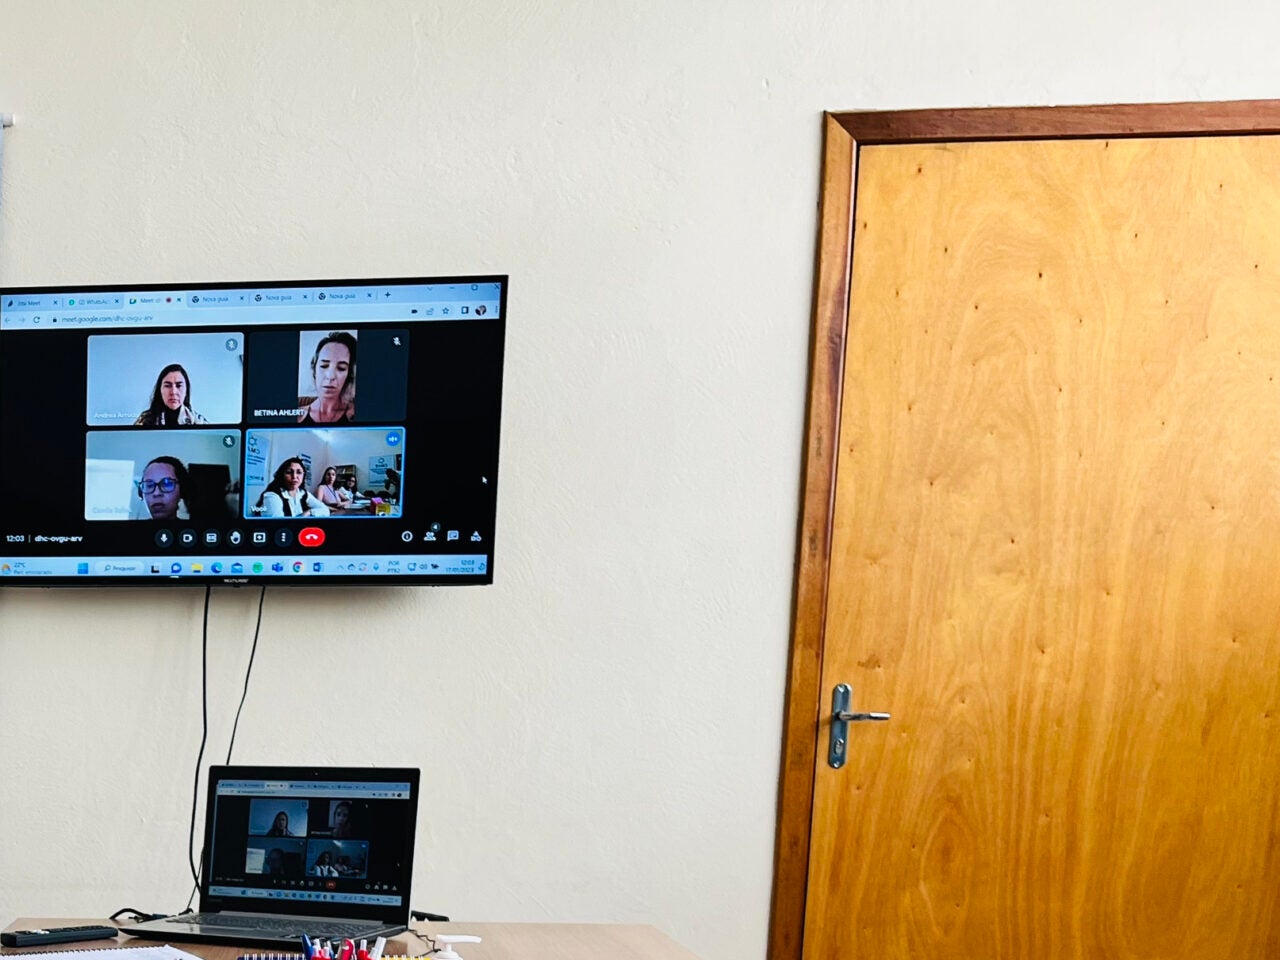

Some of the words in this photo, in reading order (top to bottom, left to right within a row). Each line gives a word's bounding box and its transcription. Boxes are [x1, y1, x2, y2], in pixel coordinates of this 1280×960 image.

[253, 409, 278, 417] BETINA
[278, 408, 305, 416] AHLERT
[6, 534, 25, 542] 12:03
